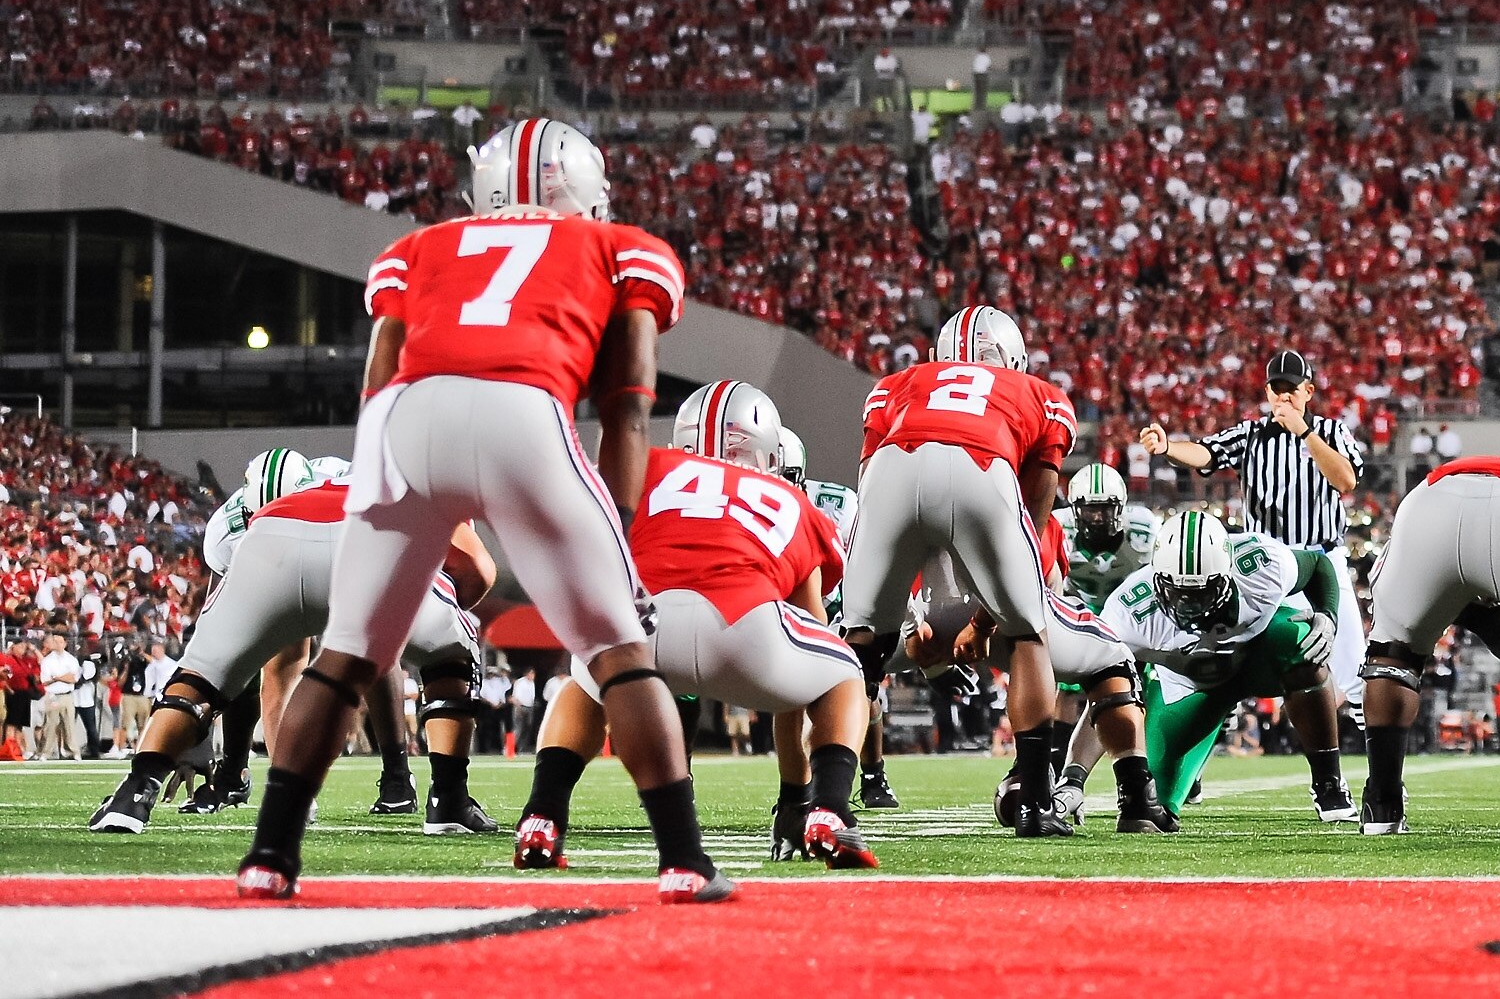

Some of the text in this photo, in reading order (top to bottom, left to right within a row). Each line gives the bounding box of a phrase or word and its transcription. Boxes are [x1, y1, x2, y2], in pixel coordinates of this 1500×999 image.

[457, 224, 554, 327] 7
[926, 365, 996, 417] 2
[648, 459, 802, 559] 49
[1232, 535, 1273, 577] 91
[1118, 581, 1160, 625] 91
